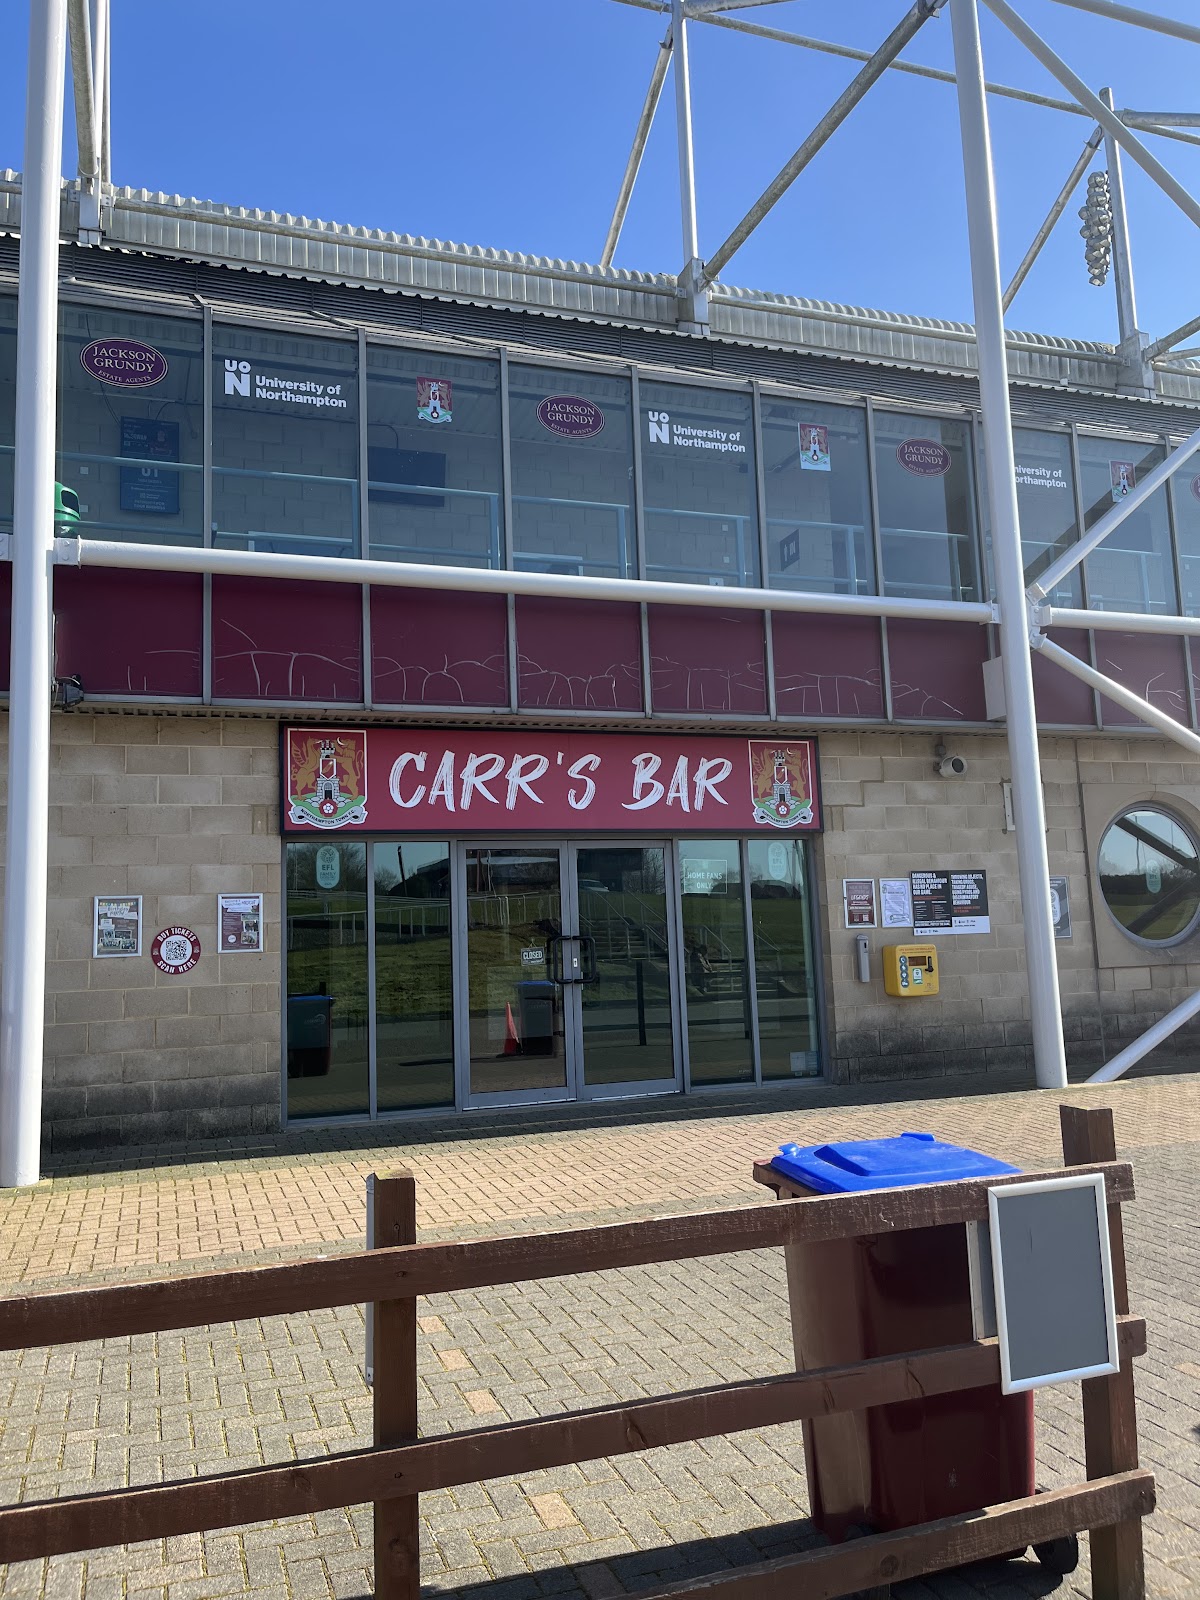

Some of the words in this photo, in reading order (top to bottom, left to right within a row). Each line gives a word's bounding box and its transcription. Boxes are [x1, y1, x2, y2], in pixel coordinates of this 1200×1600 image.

[93, 346, 156, 362] JACKSON
[94, 357, 154, 373] GRUNDY
[98, 370, 122, 382] ESTATE
[255, 375, 324, 395] University
[326, 384, 341, 395] of
[255, 387, 347, 408] Northampton
[546, 402, 595, 416] JACKSON
[547, 412, 594, 425] GRUNDY
[551, 423, 570, 434] ESTATE
[572, 427, 592, 435] AGENTS
[673, 424, 727, 441] University
[729, 431, 741, 441] of
[673, 436, 746, 452] Northampton
[904, 444, 944, 456] JACKSON
[905, 453, 944, 465] GRUNDY
[1014, 464, 1051, 478] niversity
[1052, 469, 1062, 478] of
[1015, 475, 1067, 488] orthampton
[388, 750, 602, 812] CARR'S
[621, 752, 733, 813] BAR
[300, 808, 334, 824] NORTHAMPTON
[335, 815, 349, 823] TOWN
[706, 872, 723, 880] FANS
[157, 929, 170, 942] BUY
[170, 927, 197, 942] TICKETS
[522, 950, 543, 960] CLOSED
[156, 960, 175, 973] SCAN
[177, 958, 197, 973] HERE
